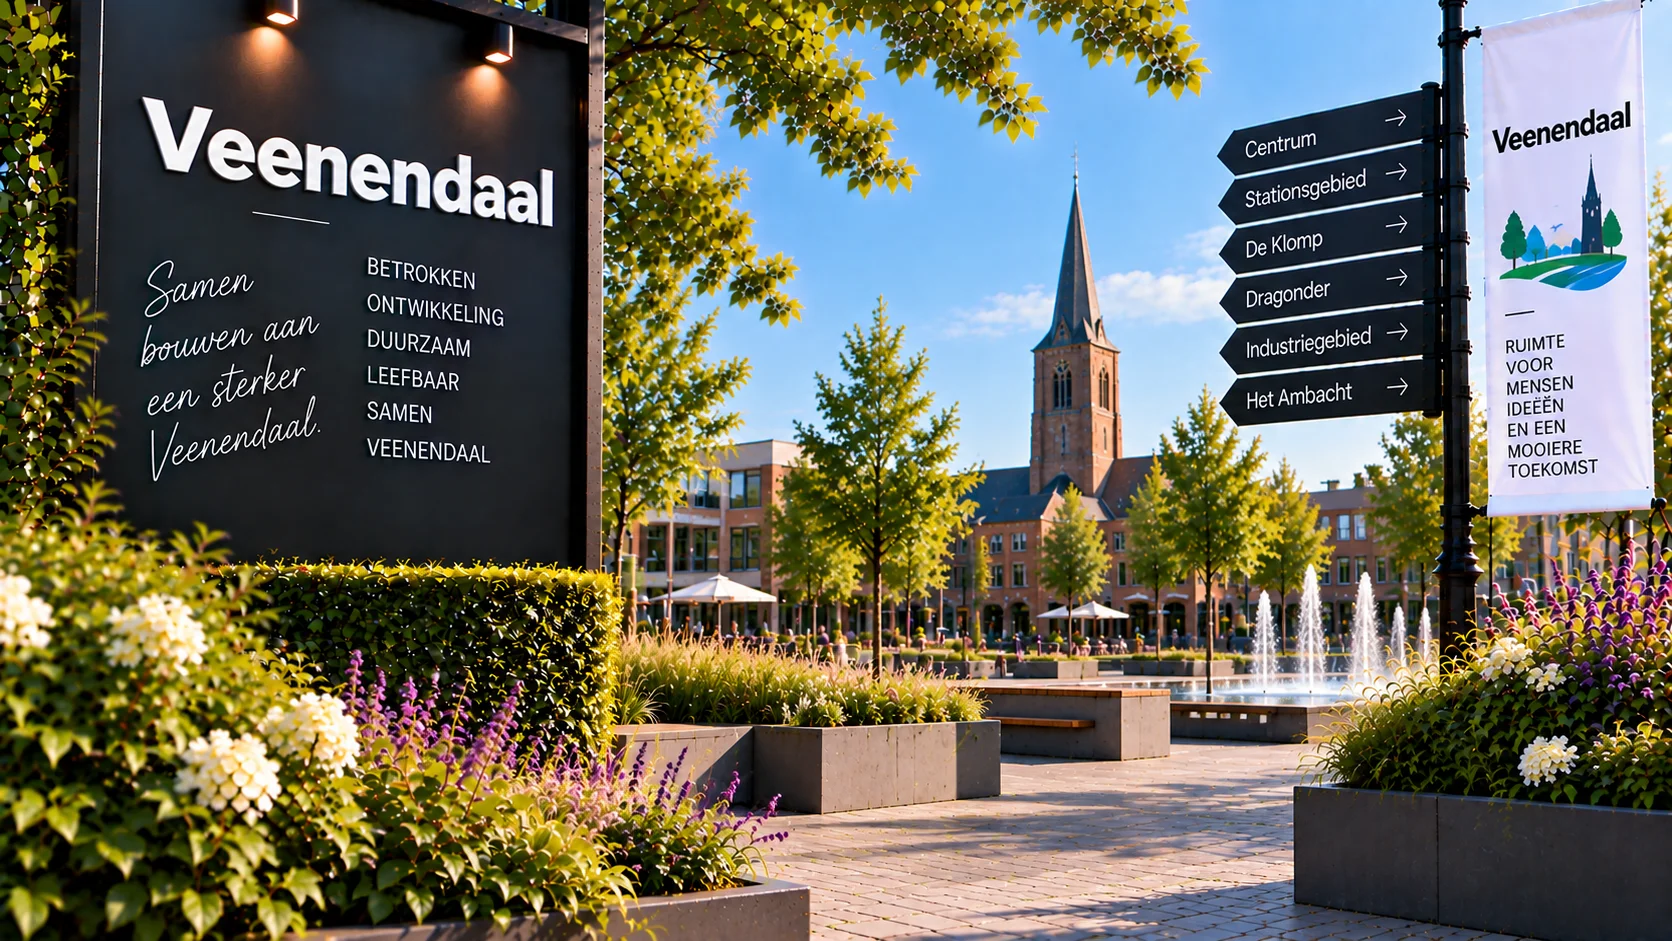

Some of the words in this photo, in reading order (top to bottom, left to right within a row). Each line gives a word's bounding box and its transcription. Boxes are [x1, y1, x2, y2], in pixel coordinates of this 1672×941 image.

[1492, 101, 1631, 153] Veenendaal
[1246, 133, 1316, 158] Centrum
[142, 96, 553, 227] Veenendaal
[1246, 168, 1366, 208] Stationsgebied
[1247, 241, 1266, 258] De
[1272, 233, 1322, 253] Klomp
[368, 257, 475, 289] BETROKKEN
[145, 260, 254, 317] Samen
[1247, 281, 1330, 308] Dragonder
[368, 294, 503, 326] ONTWIKKELING
[141, 325, 253, 367] bouwen
[264, 316, 319, 341] aan
[368, 329, 470, 357] DUURZAAM
[1247, 326, 1371, 358] Industriegebied
[1506, 334, 1565, 353] RUIMTE
[368, 366, 459, 391] LEEFBAAR
[1506, 357, 1552, 374] VOOR
[148, 389, 200, 415] een
[212, 354, 305, 407] sterker
[1248, 391, 1274, 409] Het
[1278, 383, 1352, 406] Ambacht
[1507, 376, 1573, 395] MENSEN
[368, 401, 431, 423] SAMEN
[150, 396, 320, 481] Veenendaal.
[1508, 422, 1527, 437] EN
[1535, 419, 1565, 435] EEN
[367, 438, 490, 463] VEENENDAAL
[1509, 440, 1582, 458] MOOIERE
[1508, 459, 1598, 478] TOEKOMST
